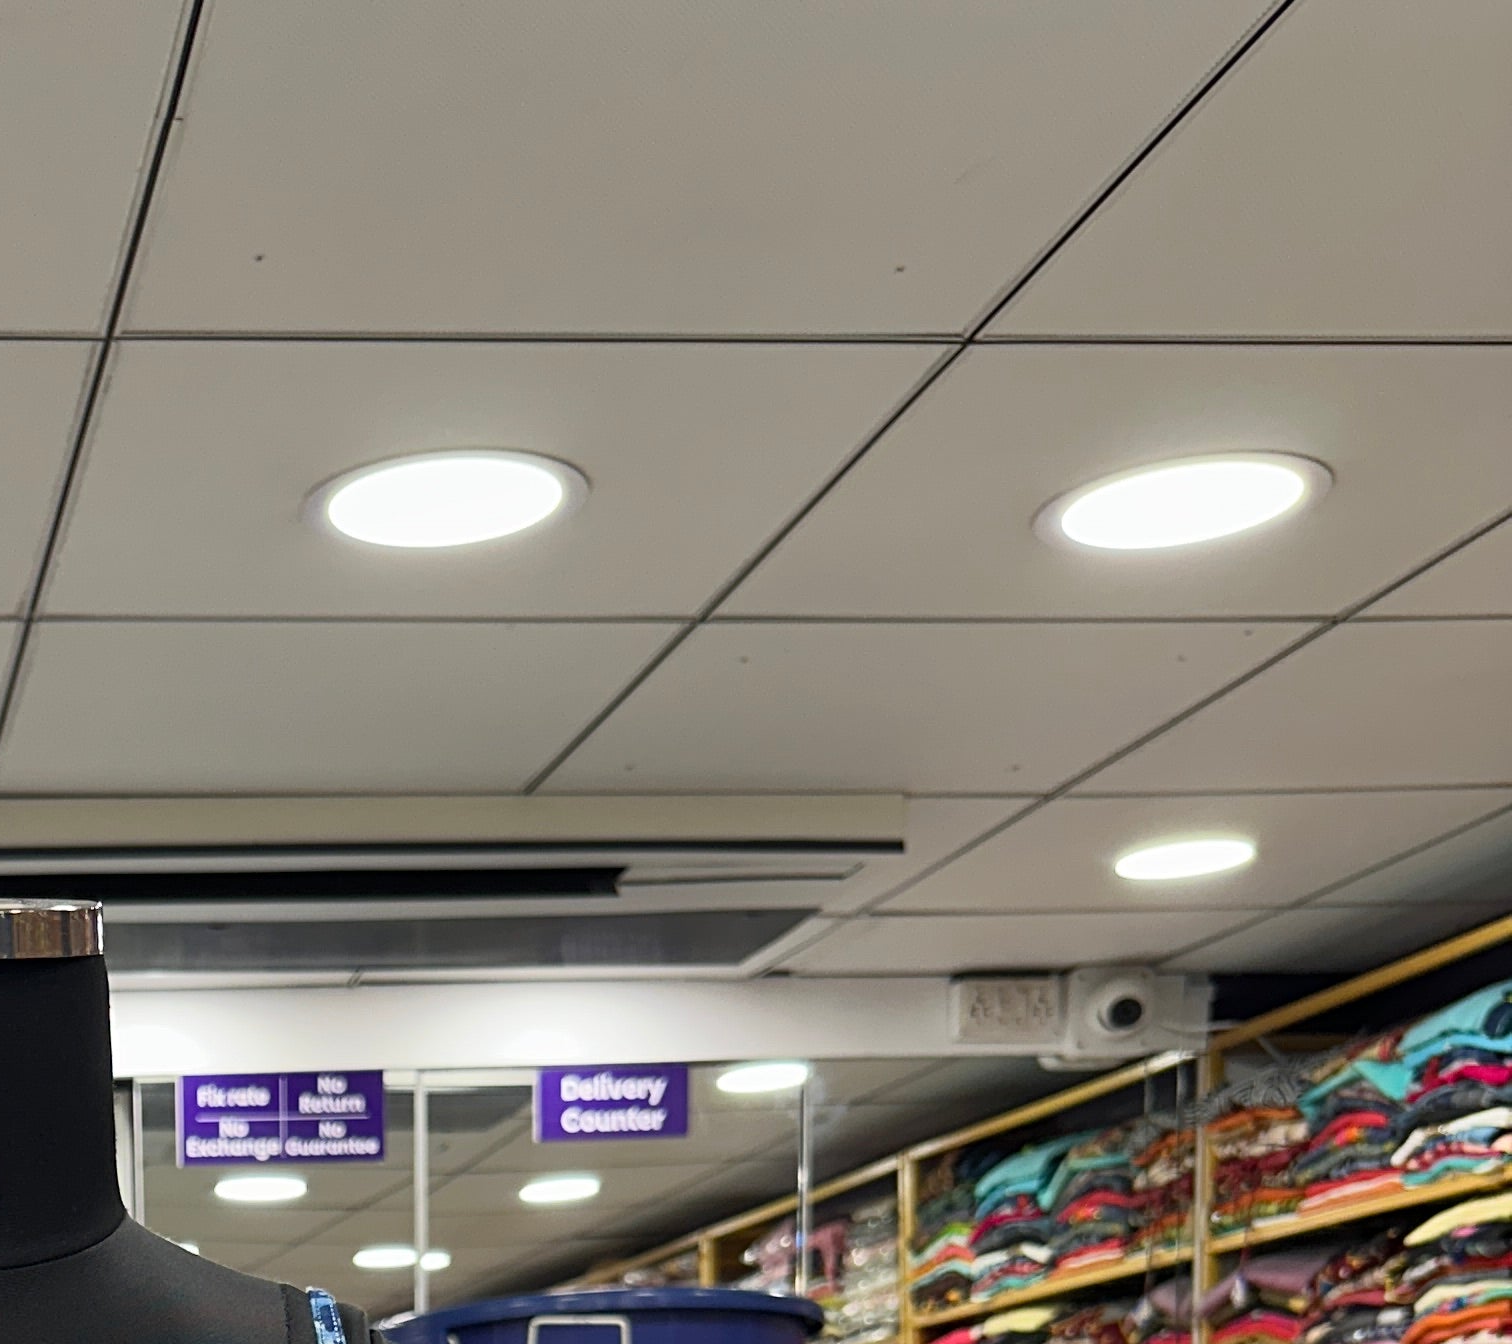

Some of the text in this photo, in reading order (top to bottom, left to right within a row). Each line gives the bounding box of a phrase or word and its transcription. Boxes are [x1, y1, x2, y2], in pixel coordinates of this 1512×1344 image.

[560, 1072, 668, 1106] Delivery
[298, 1092, 366, 1114] Return
[560, 1106, 667, 1133] Counter
[186, 1136, 282, 1161] Exchange
[285, 1136, 380, 1156] Guarantee
